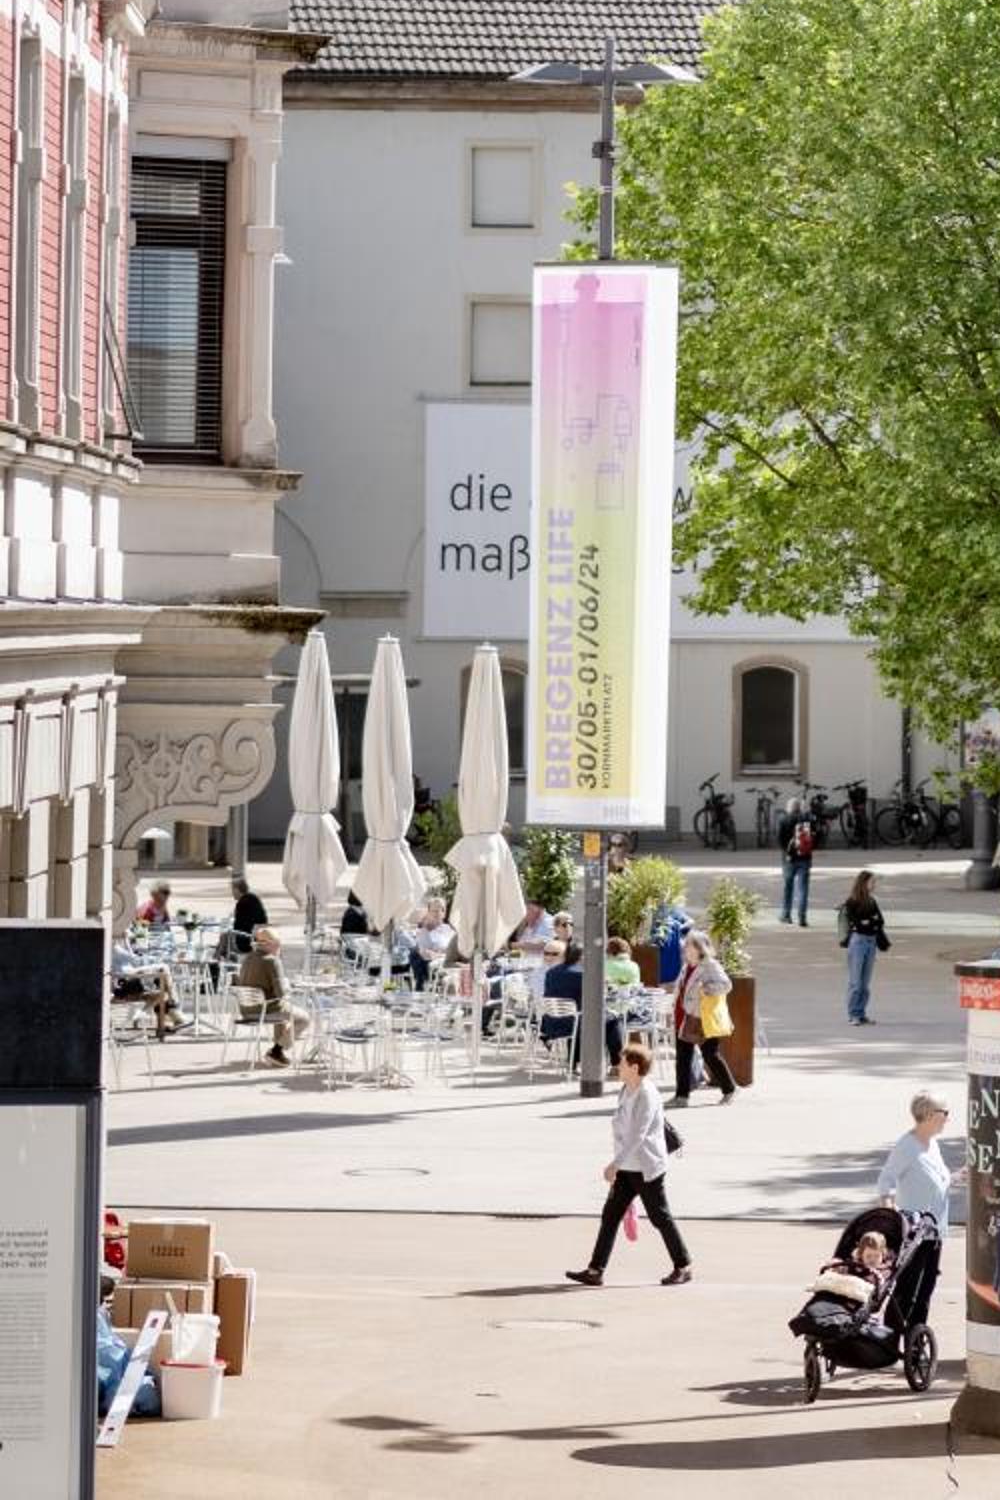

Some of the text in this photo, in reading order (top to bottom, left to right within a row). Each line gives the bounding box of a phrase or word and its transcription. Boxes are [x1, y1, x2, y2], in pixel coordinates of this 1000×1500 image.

[450, 473, 512, 511] die
[547, 507, 575, 586] LIFE
[544, 600, 574, 790] BREGENZ
[576, 543, 601, 791] 30/05-01/06/24
